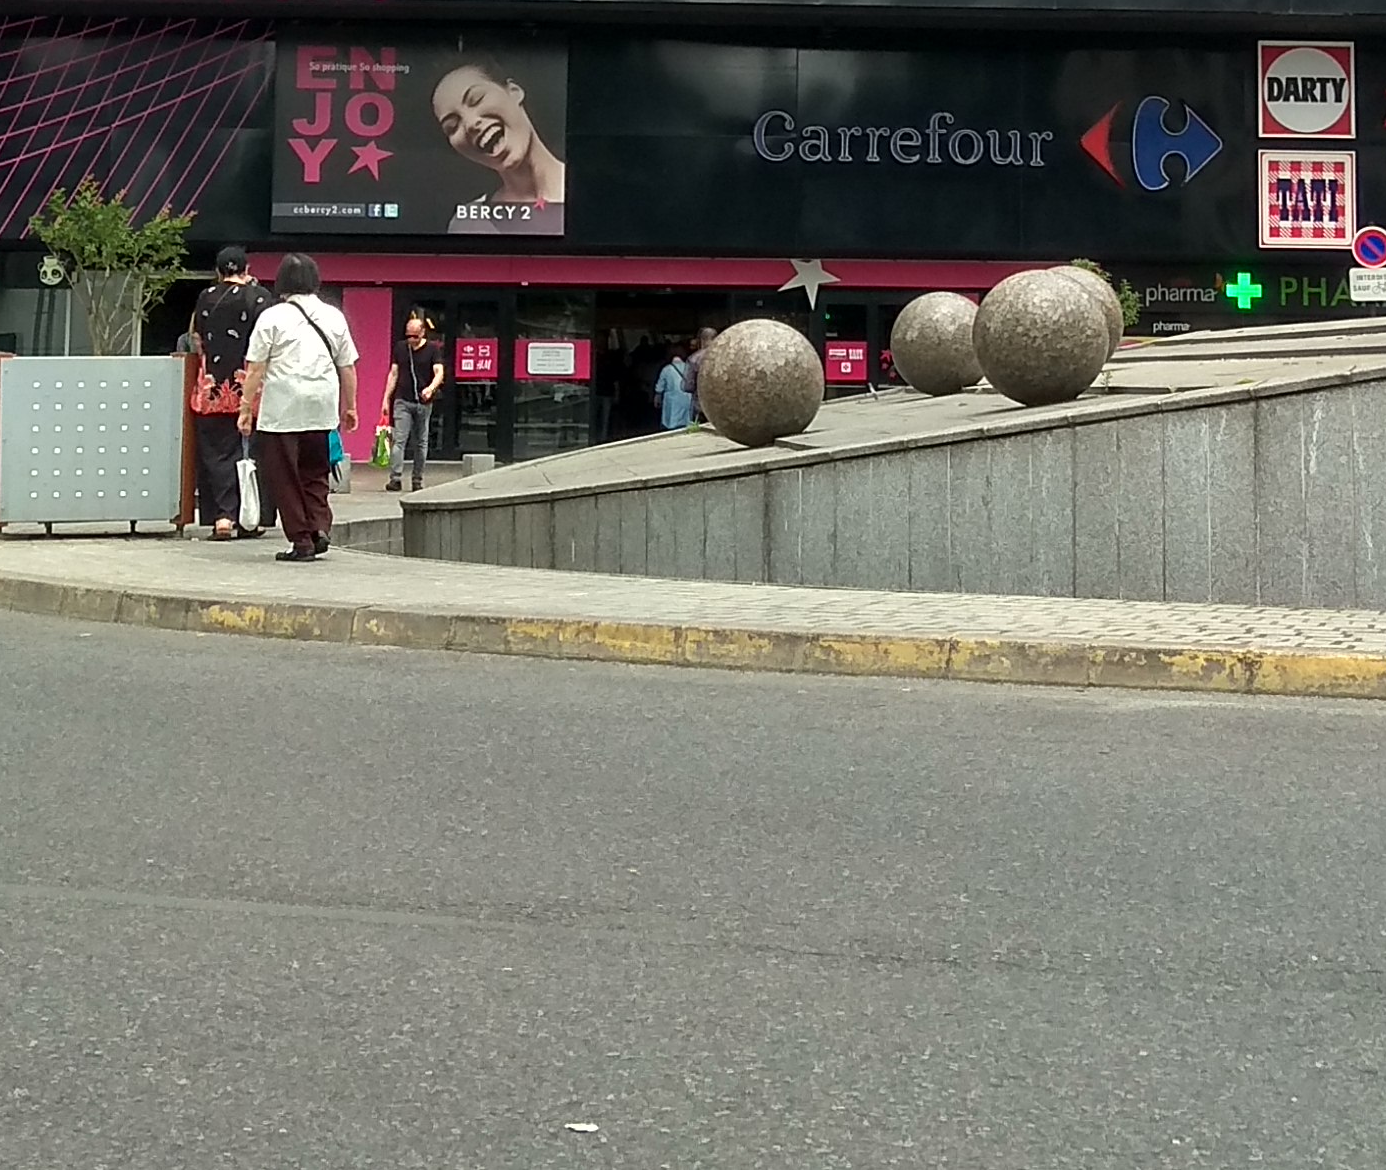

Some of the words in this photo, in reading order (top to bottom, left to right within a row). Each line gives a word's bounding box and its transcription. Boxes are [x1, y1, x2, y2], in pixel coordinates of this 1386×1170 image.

[309, 61, 320, 72] So
[322, 61, 358, 74] pratique
[359, 61, 370, 72] So
[373, 62, 410, 74] shopping
[1267, 76, 1346, 103] DARTY
[753, 110, 1053, 166] Carrefour
[1276, 178, 1338, 223] TATI
[293, 204, 362, 217] ccbercy2.com
[456, 204, 516, 219] BERCY
[520, 206, 531, 220] 2
[1353, 284, 1371, 292] SAUF
